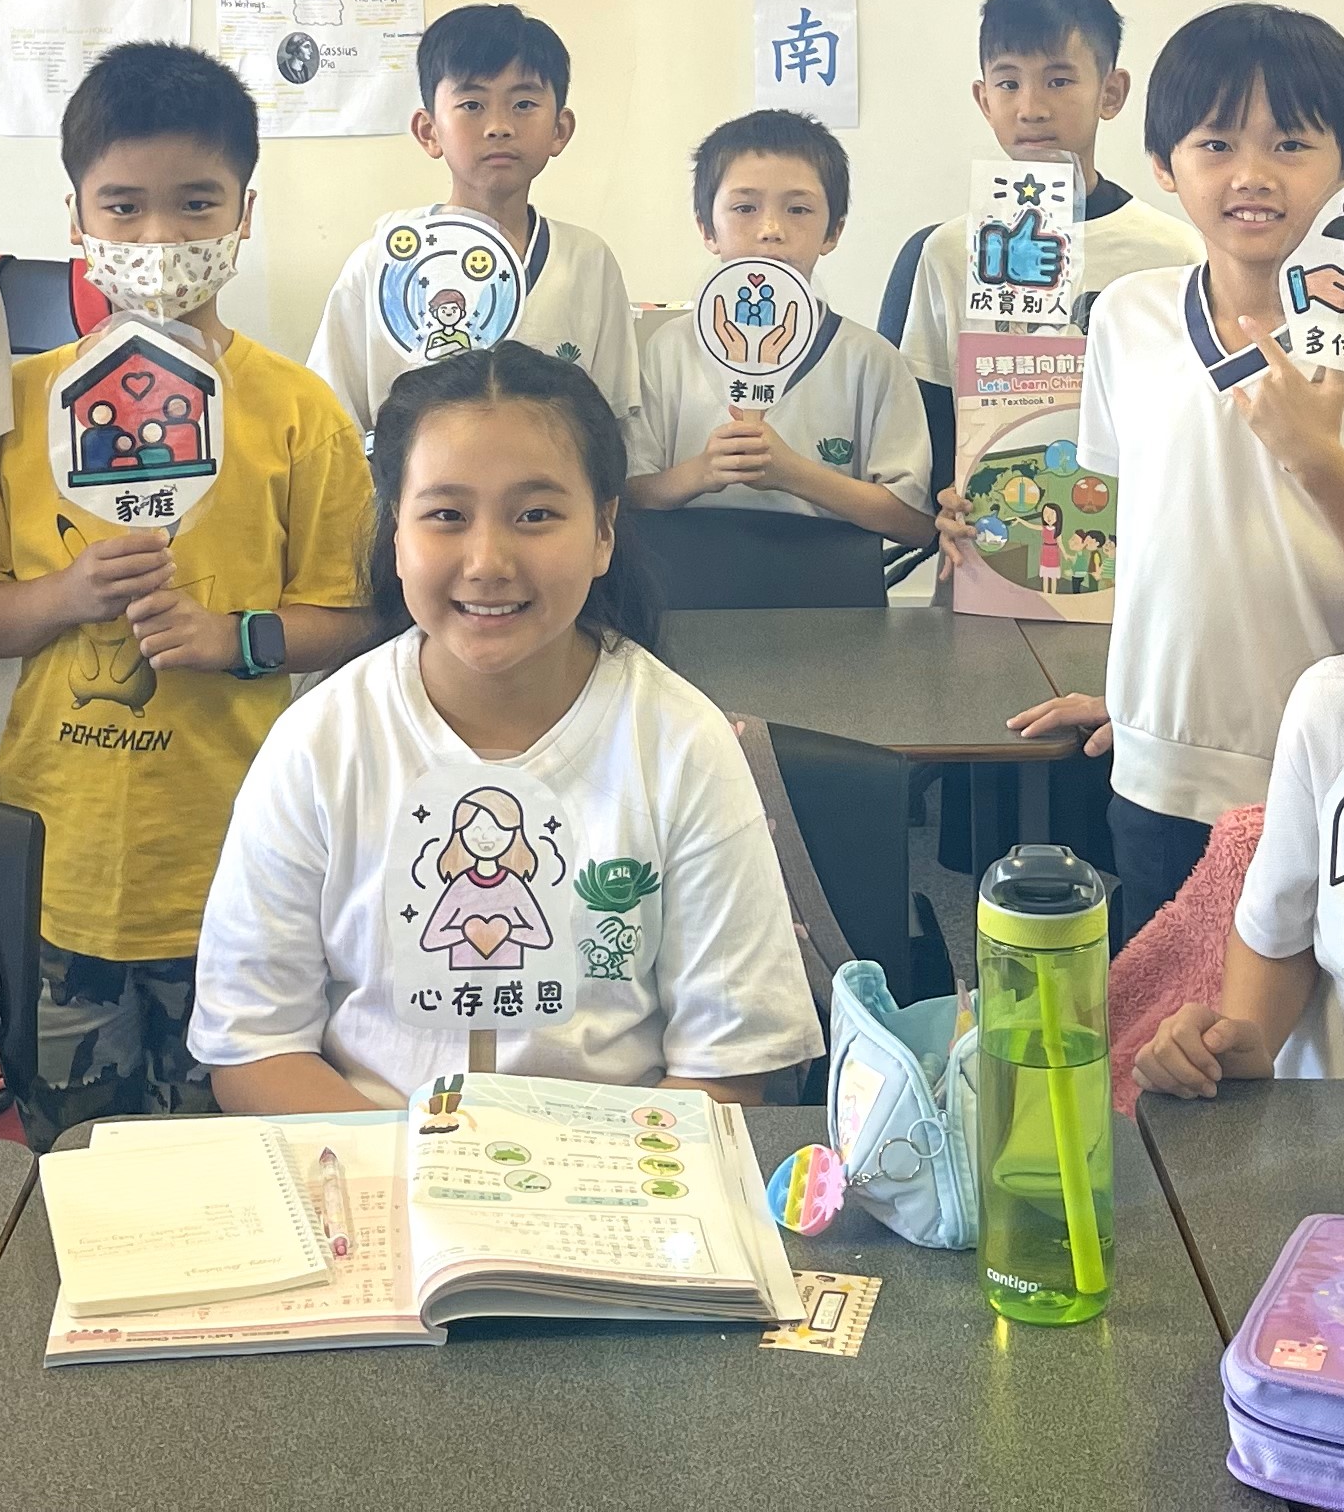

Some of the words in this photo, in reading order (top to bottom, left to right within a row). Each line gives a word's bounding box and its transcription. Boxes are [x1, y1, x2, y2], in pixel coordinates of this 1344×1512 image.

[319, 44, 358, 56] Cassius
[771, 7, 840, 86] 南
[969, 291, 1068, 317] 欣賞別人
[729, 379, 775, 404] 孝順
[978, 378, 1011, 392] Let's
[1012, 378, 1049, 391] Learn
[1002, 396, 1044, 406] Textbook
[116, 489, 177, 523] 家庭
[59, 720, 173, 751] POKÉMON
[410, 980, 564, 1017] 心存感恩
[986, 1266, 1039, 1294] contigo
